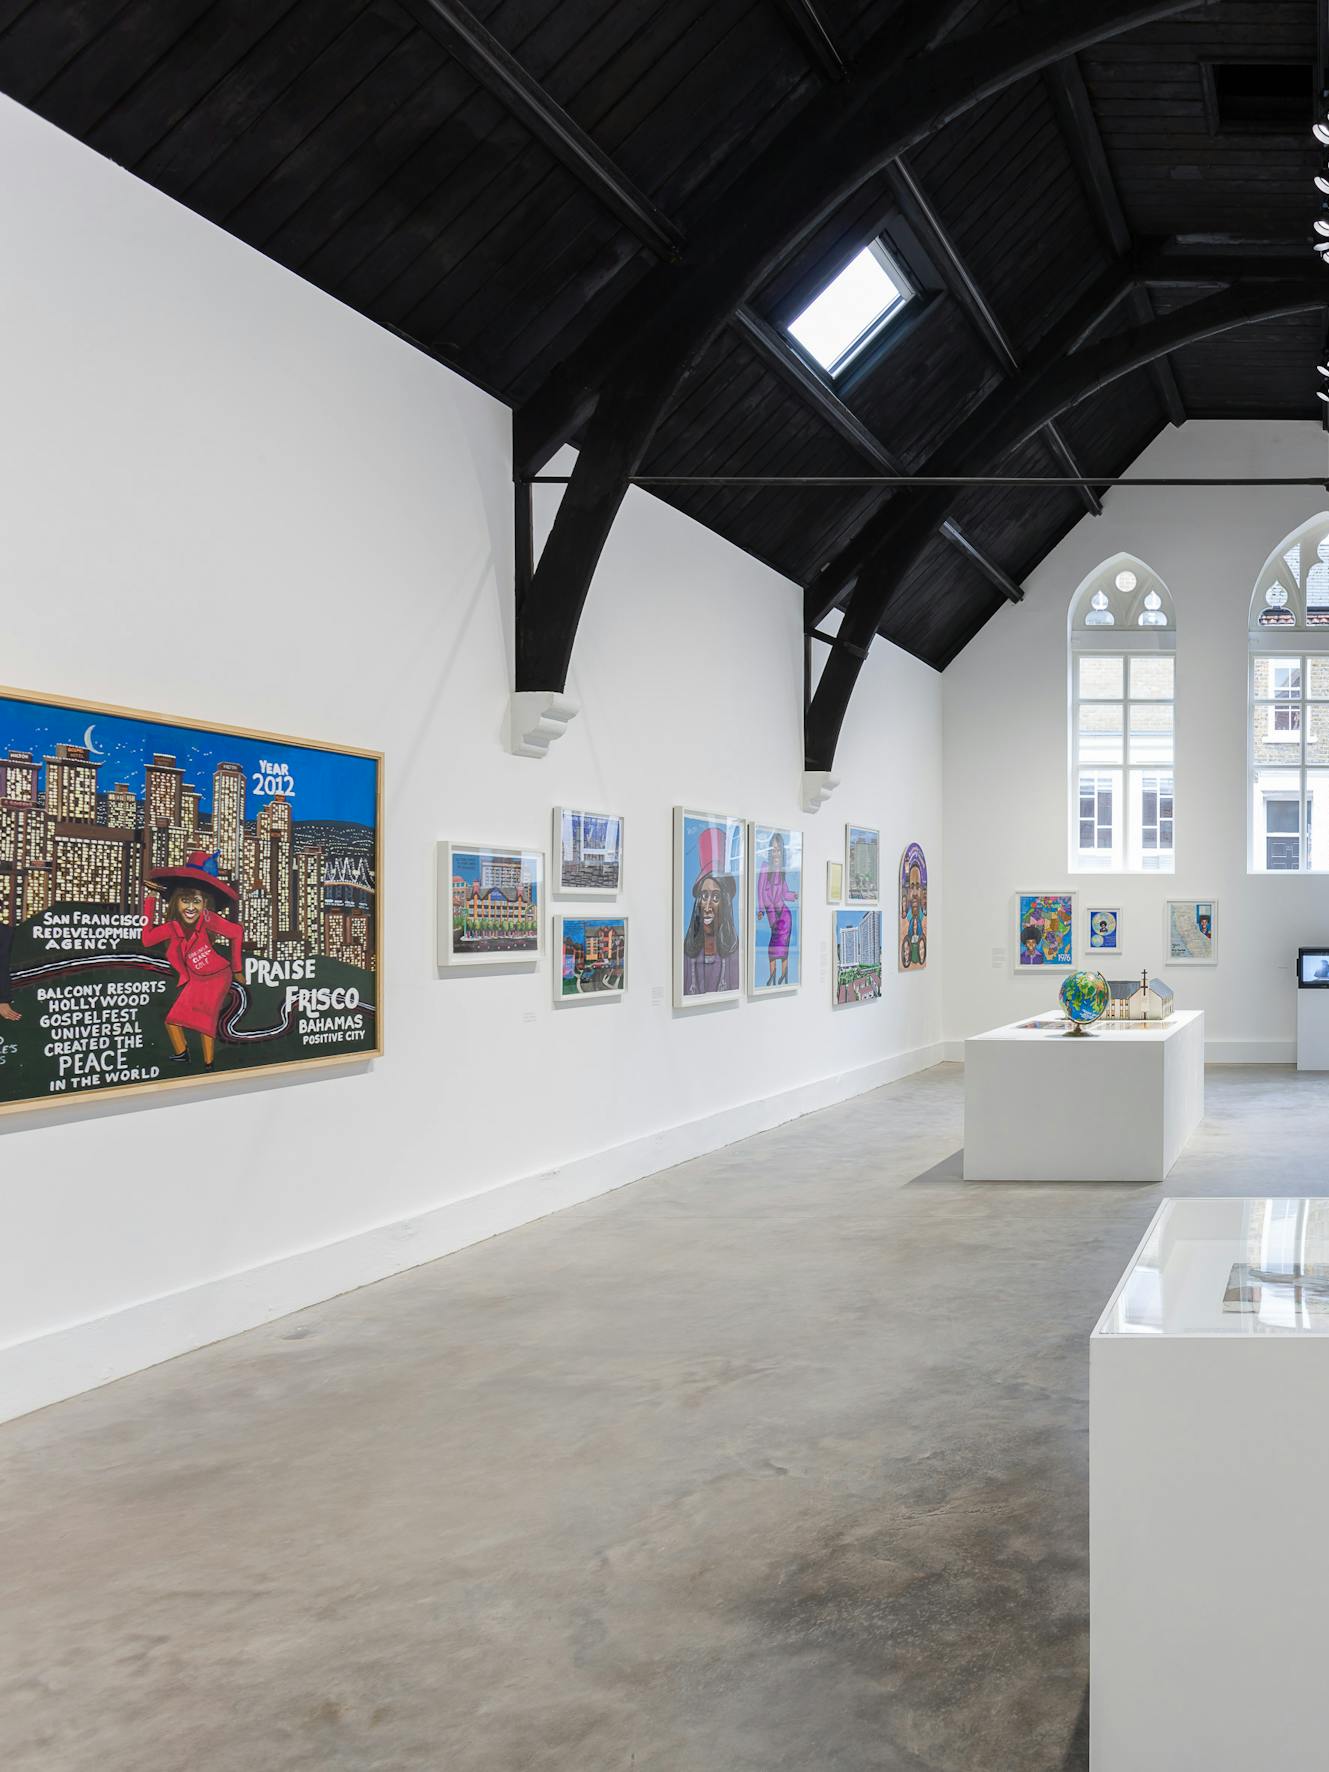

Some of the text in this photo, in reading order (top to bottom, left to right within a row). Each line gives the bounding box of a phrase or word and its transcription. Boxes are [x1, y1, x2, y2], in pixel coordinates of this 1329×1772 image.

[258, 759, 289, 776] YEAR
[252, 773, 296, 797] 2012
[43, 911, 149, 927] SAN FRANCISCO
[32, 926, 143, 940] REDEVELOPMENT
[45, 938, 120, 950] AGENCY
[245, 957, 316, 987] PRAISE
[37, 981, 167, 1001] BALCONY RESORTS
[48, 994, 150, 1013] HOLLYWOOD
[286, 986, 360, 1018] FRISCO
[40, 1008, 139, 1028] GOSPELFEST
[298, 1014, 363, 1034] BAHAMAS
[51, 1021, 142, 1040] UNIVERSAL
[303, 1030, 366, 1045] POSITIVE CITY
[44, 1034, 144, 1057] CREATED THE
[58, 1048, 129, 1077] PEACE
[49, 1066, 160, 1092] IN THE WORLD
